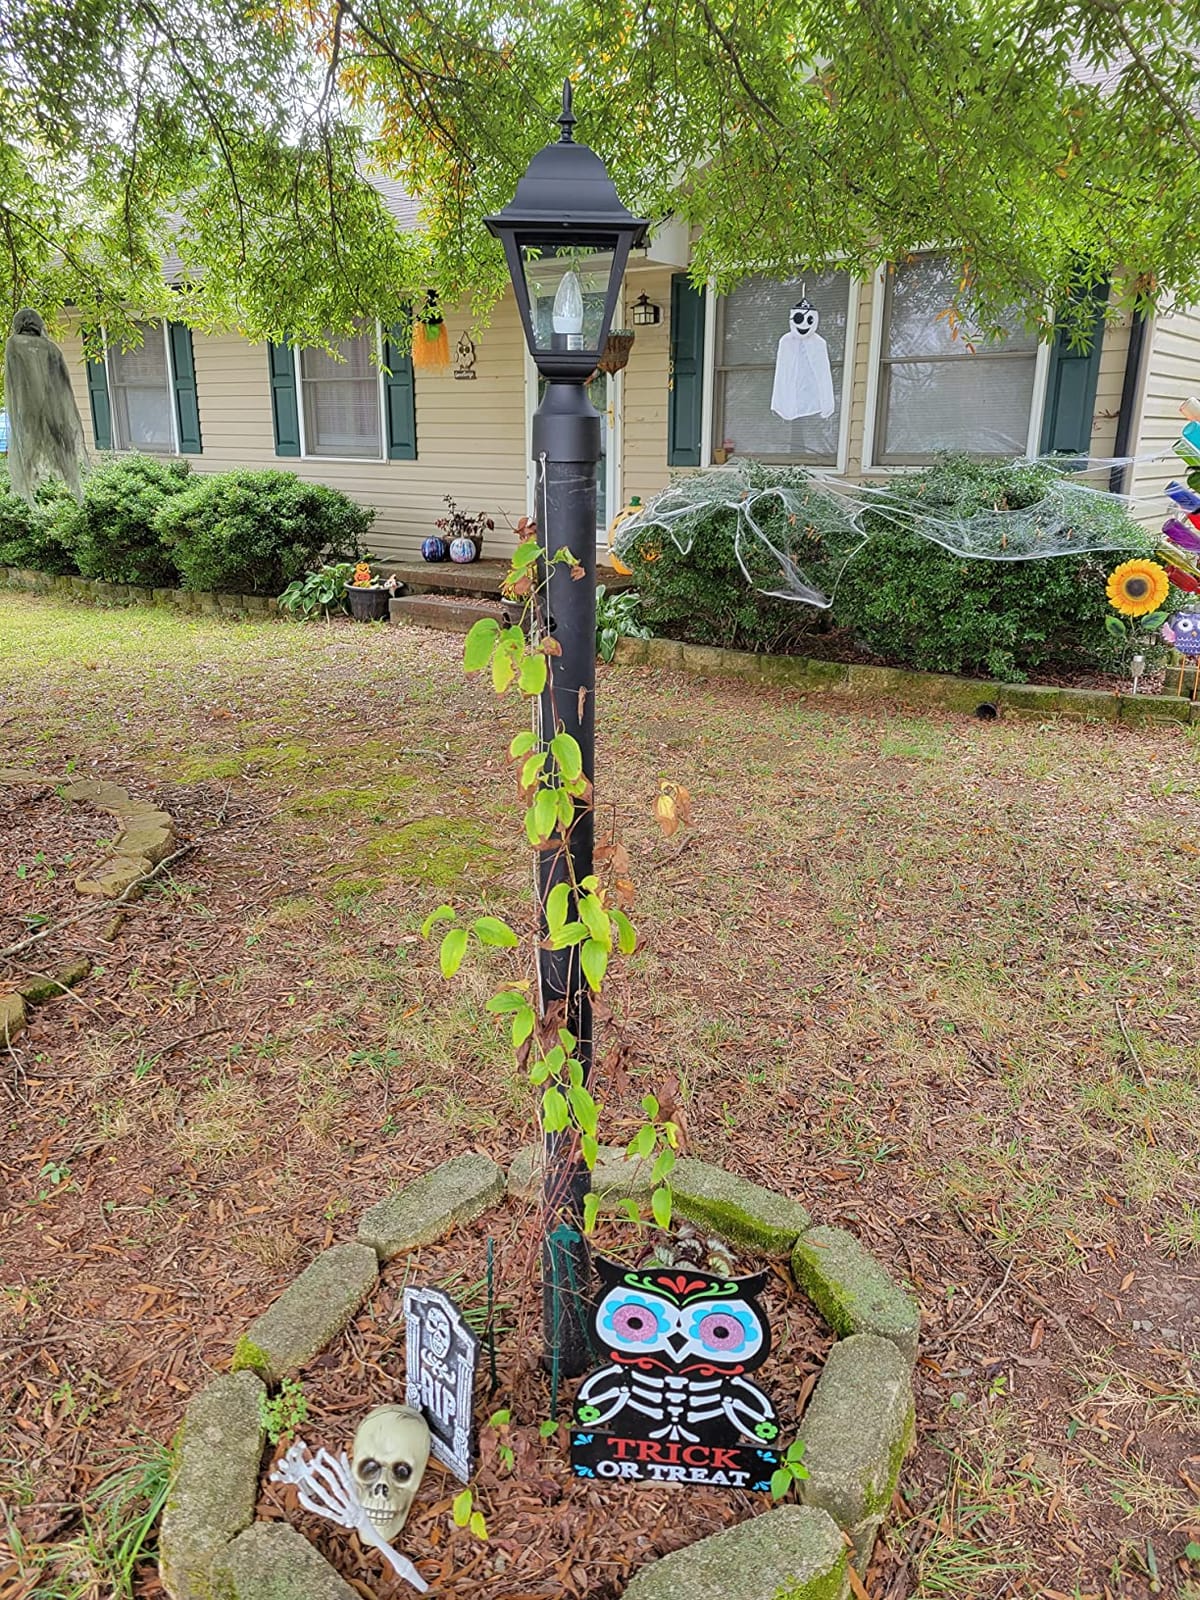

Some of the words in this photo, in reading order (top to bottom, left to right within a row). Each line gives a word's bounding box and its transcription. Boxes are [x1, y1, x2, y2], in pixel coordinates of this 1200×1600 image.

[421, 1367, 456, 1425] RIP
[607, 1437, 741, 1469] TRICK
[596, 1460, 644, 1479] OR
[647, 1464, 751, 1487] TREAT
